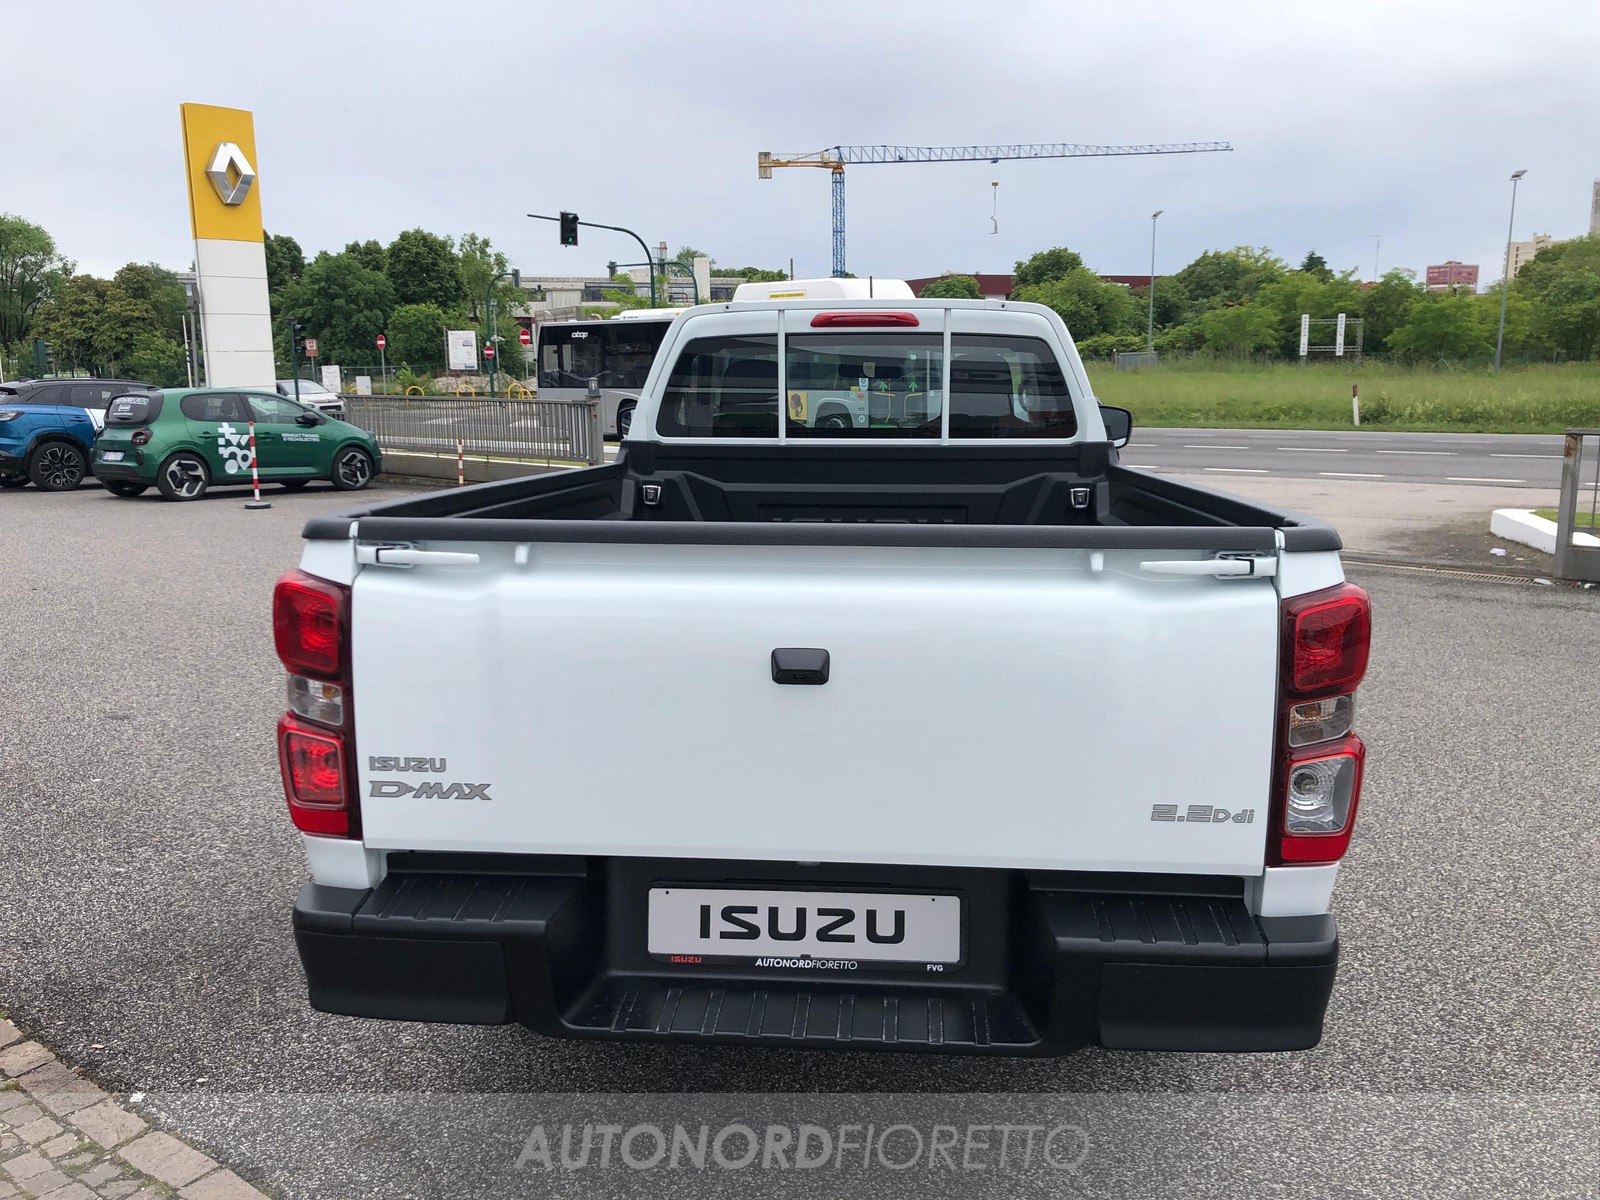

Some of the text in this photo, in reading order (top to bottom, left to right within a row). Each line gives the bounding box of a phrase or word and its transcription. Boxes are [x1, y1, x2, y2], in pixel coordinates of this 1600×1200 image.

[369, 756, 447, 773] ISUZU
[368, 780, 492, 801] D-MAX
[699, 904, 905, 944] ISUZU
[671, 955, 702, 964] ISUZU
[755, 958, 858, 970] AUTONORDFIORETTO
[926, 964, 944, 972] FVG
